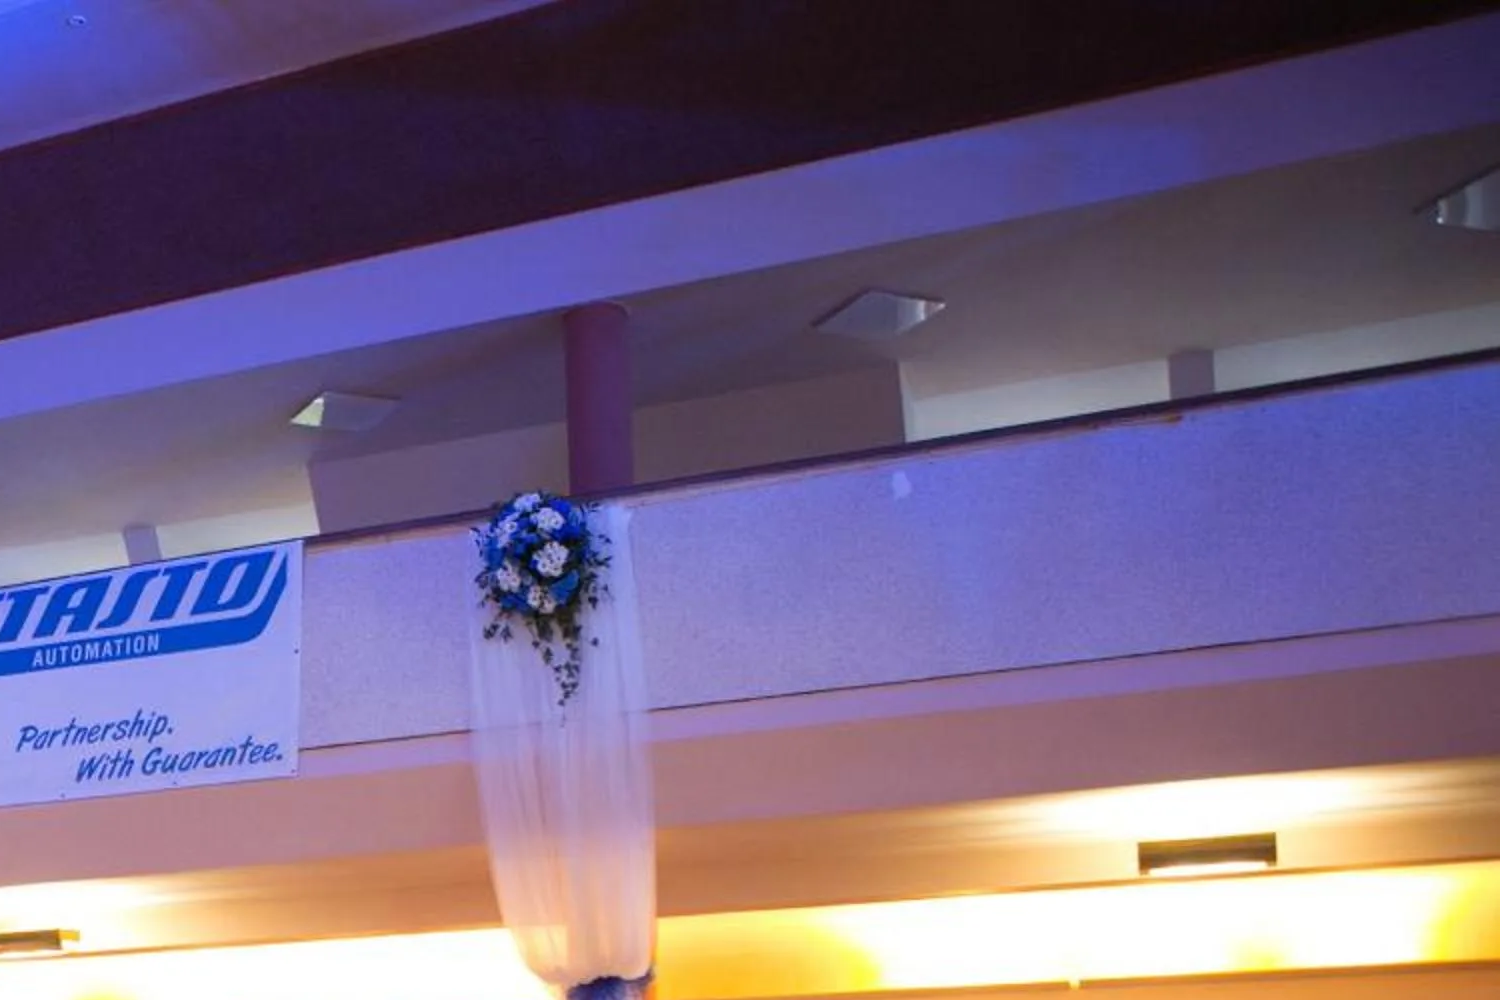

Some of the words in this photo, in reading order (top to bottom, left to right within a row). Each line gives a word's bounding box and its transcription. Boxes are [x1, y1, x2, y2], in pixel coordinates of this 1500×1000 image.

[31, 632, 160, 668] AUTOMATION
[15, 708, 174, 752] Partnership.
[75, 750, 135, 783] With
[141, 735, 283, 776] Guarantee.
